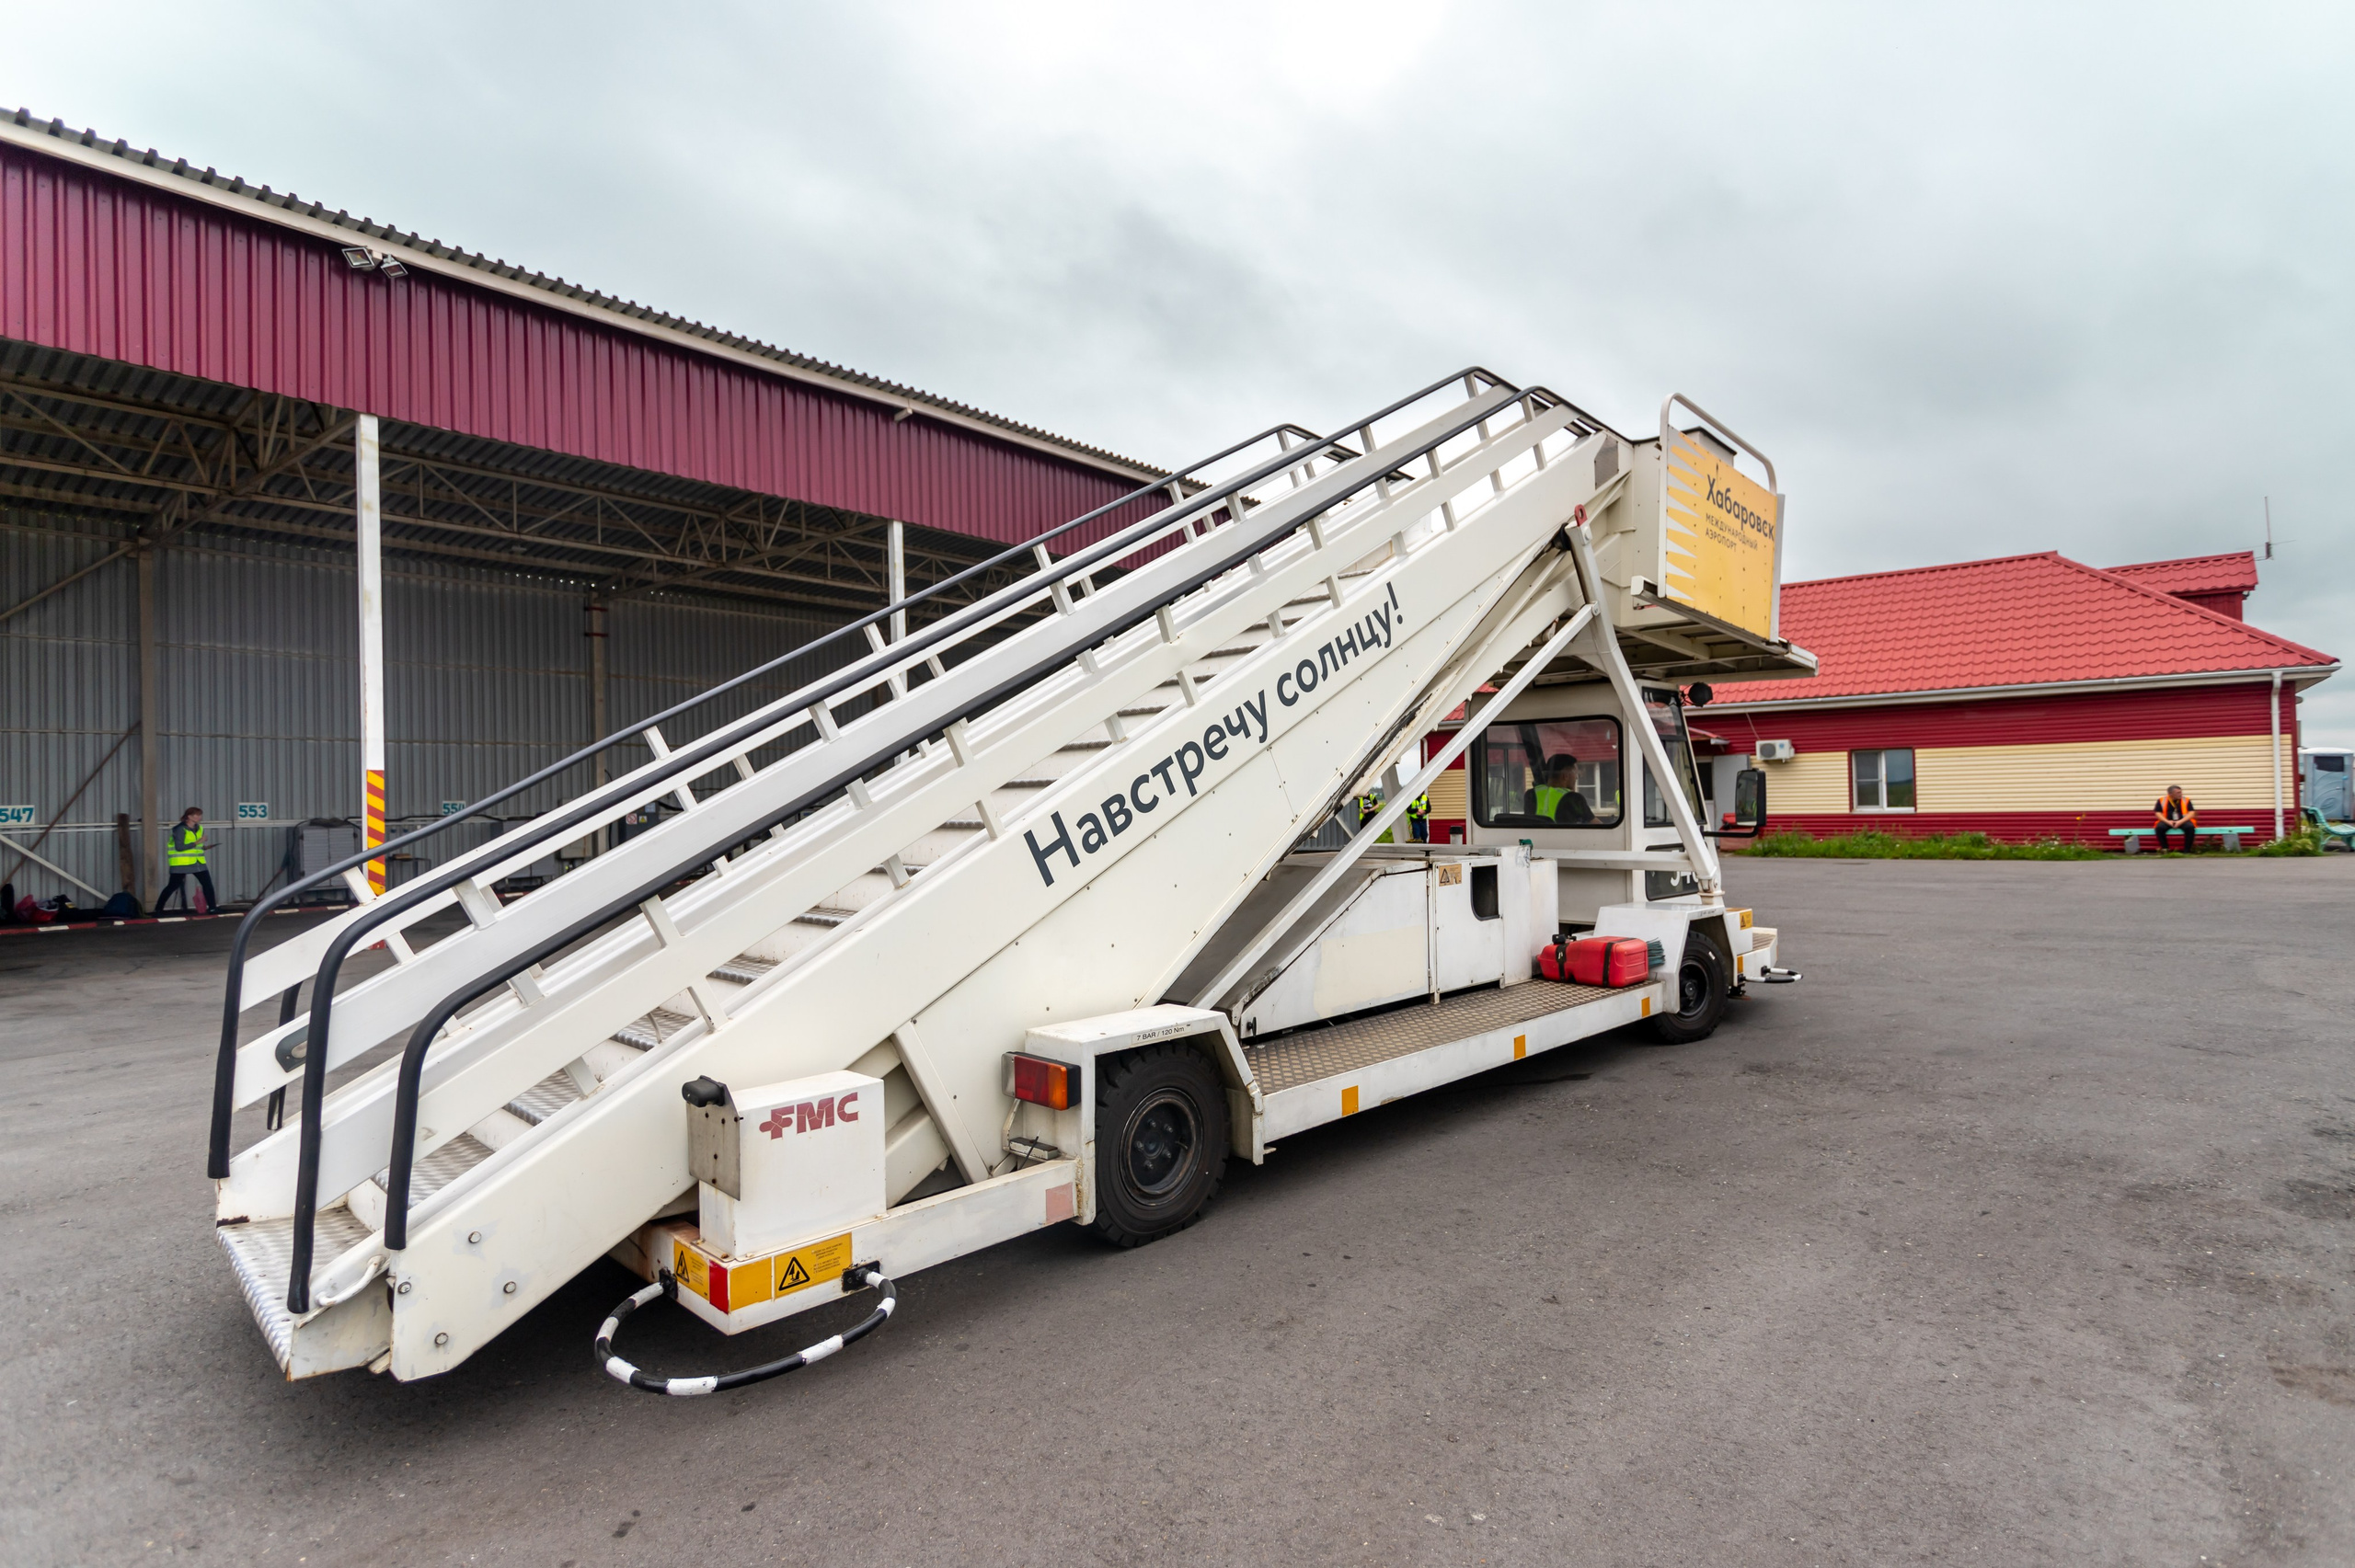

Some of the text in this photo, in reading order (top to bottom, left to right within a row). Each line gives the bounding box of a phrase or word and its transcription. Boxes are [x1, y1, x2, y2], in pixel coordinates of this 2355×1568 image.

[1706, 474, 1775, 542] Хабаровск
[1706, 512, 1758, 551] МЕЖДУНАРОДНЫЙ
[1706, 527, 1737, 552] АЭРОПОРТ
[1024, 581, 1404, 887] Навстречу солнцу!
[0, 807, 34, 823] 547
[238, 804, 268, 818] 553
[1142, 1031, 1156, 1040] BAR
[1161, 1028, 1173, 1036] 120
[759, 1092, 859, 1141] FMC
